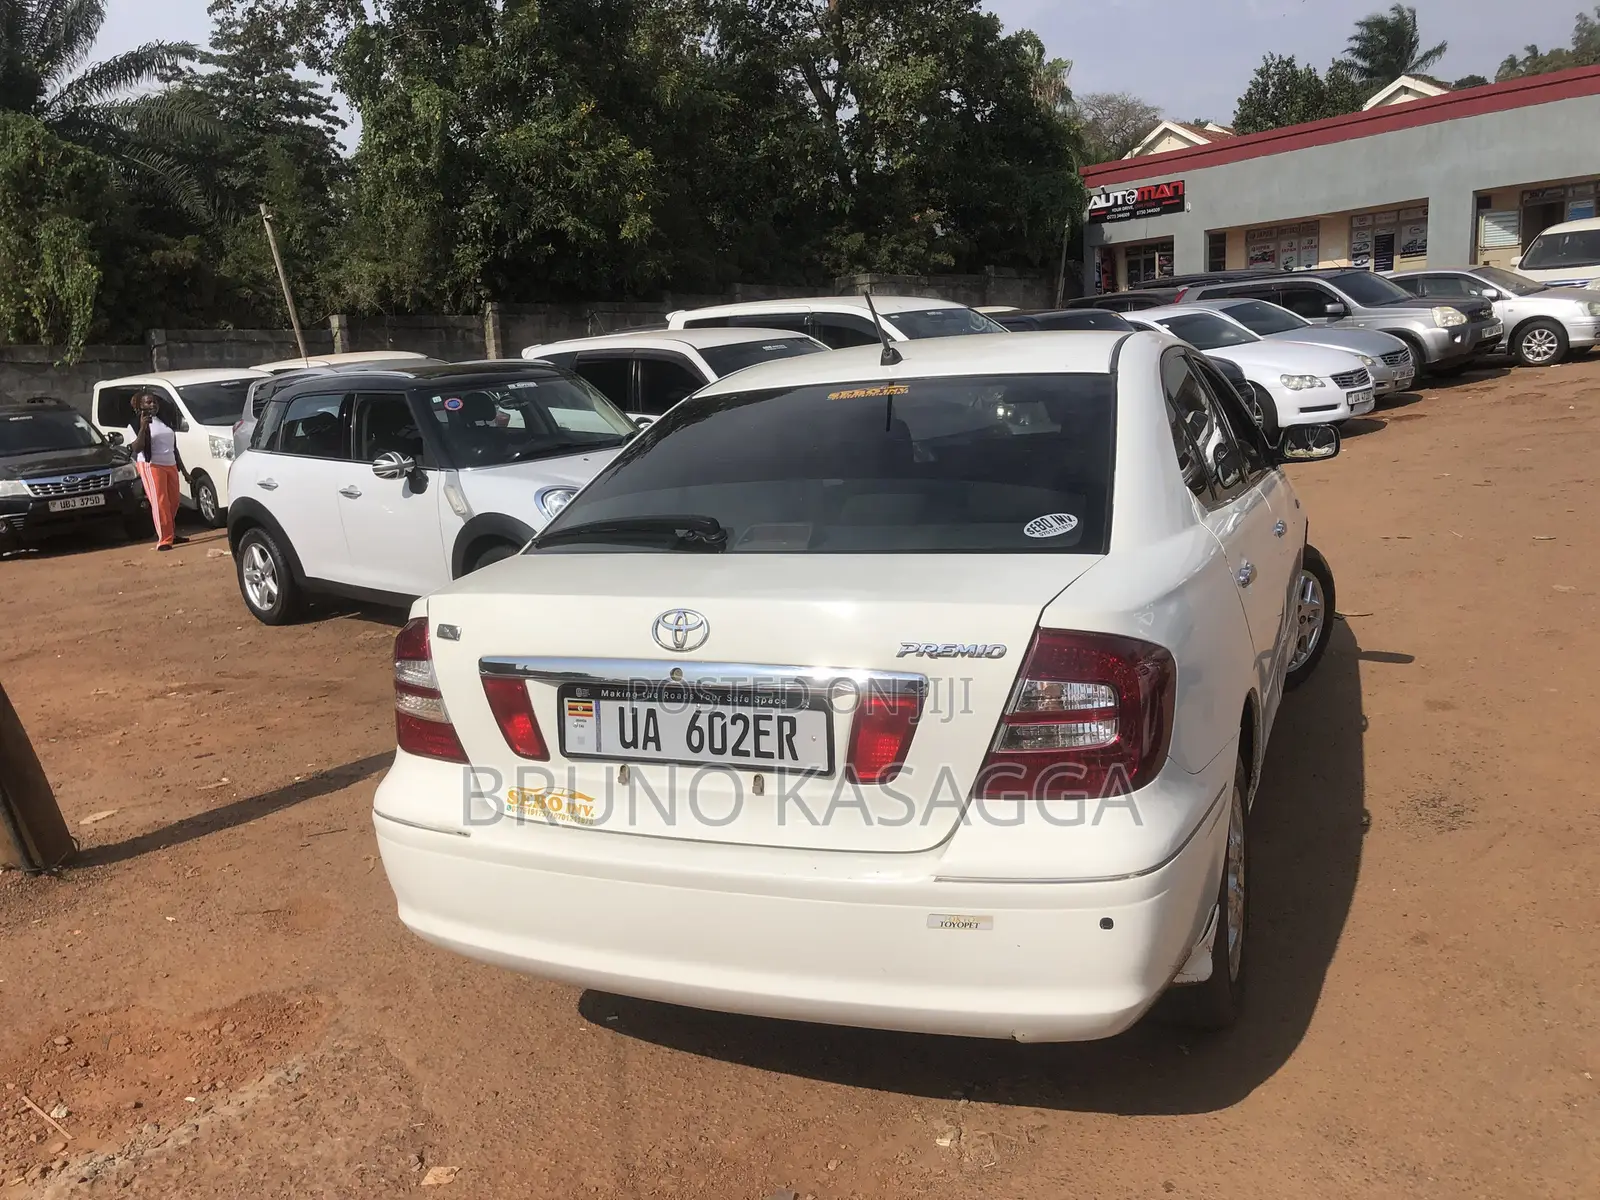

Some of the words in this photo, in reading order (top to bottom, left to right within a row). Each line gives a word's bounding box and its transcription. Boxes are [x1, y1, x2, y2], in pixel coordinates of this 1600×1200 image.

[1027, 518, 1053, 535] SEBO
[896, 642, 1007, 659] PREMIO
[601, 689, 637, 700] Making
[664, 691, 694, 700] Roads
[727, 694, 749, 703] Safe
[754, 695, 787, 706] Space
[618, 706, 662, 752] UA
[686, 709, 799, 761] 602ER
[507, 789, 563, 812] SEBO
[940, 921, 980, 929] TOYOPET
